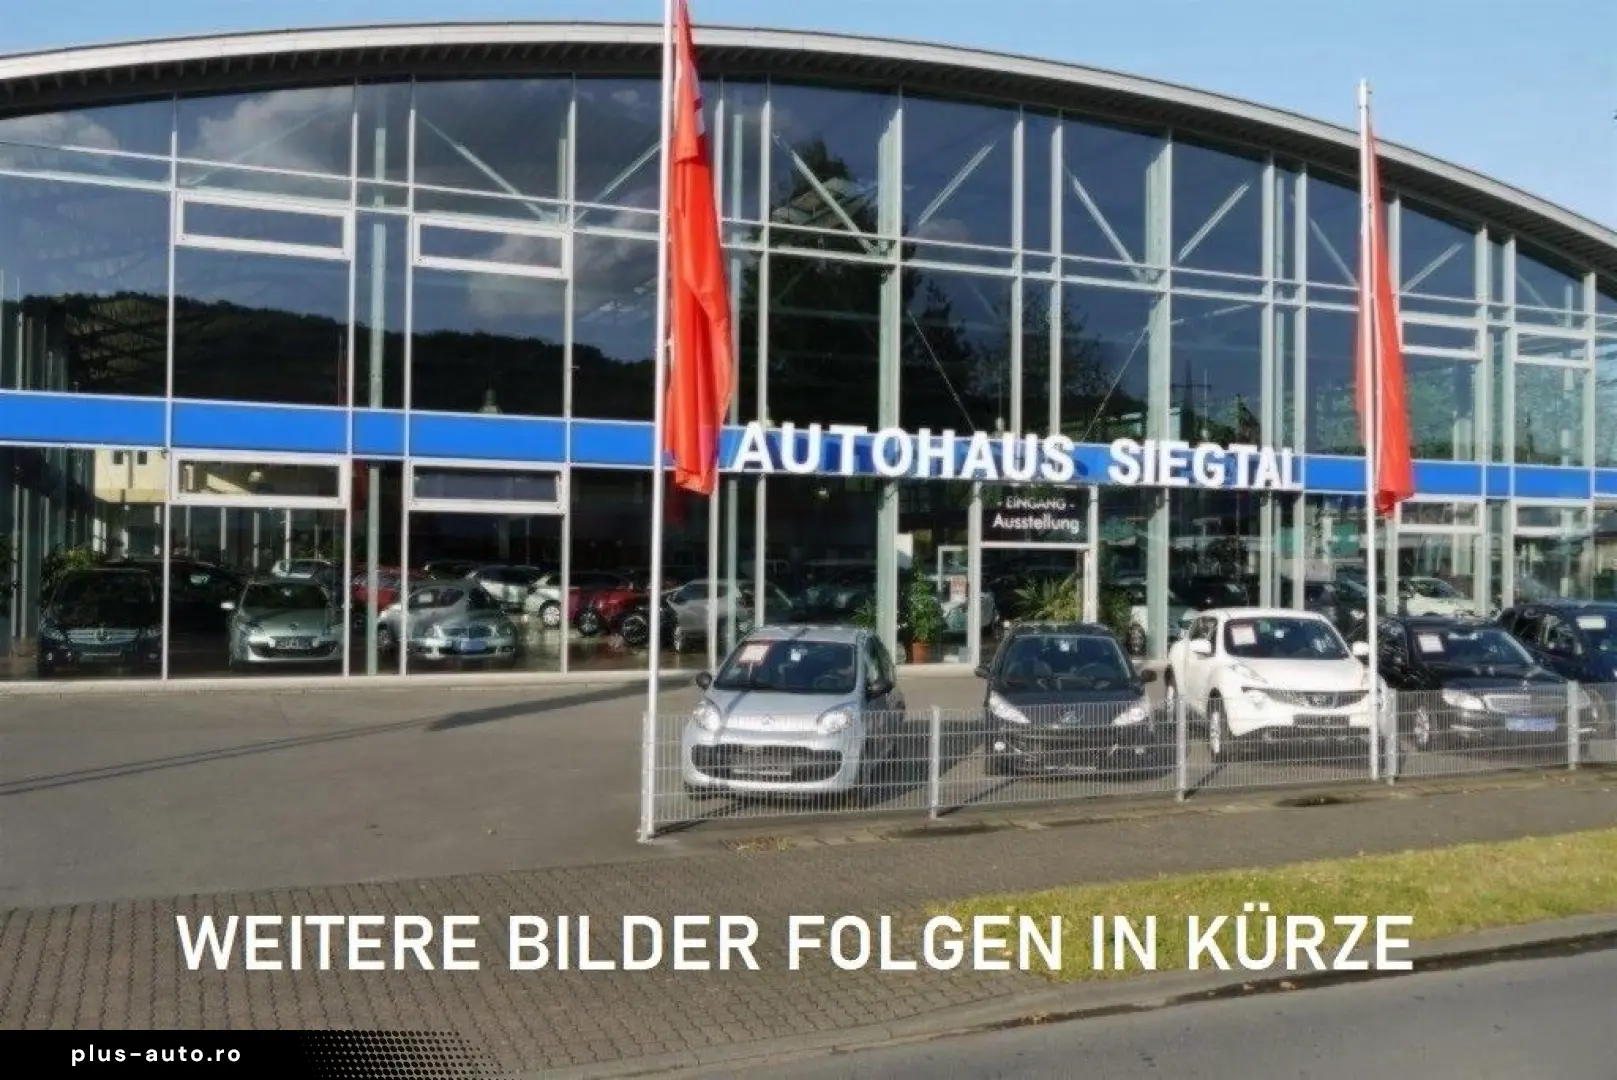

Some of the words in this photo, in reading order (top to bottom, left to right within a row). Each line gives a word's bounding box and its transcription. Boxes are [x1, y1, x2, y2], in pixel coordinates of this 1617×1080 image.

[732, 421, 1075, 482] AUTOHAUS
[1108, 438, 1305, 490] SIEGTAL
[992, 513, 1079, 534] Ausstellung
